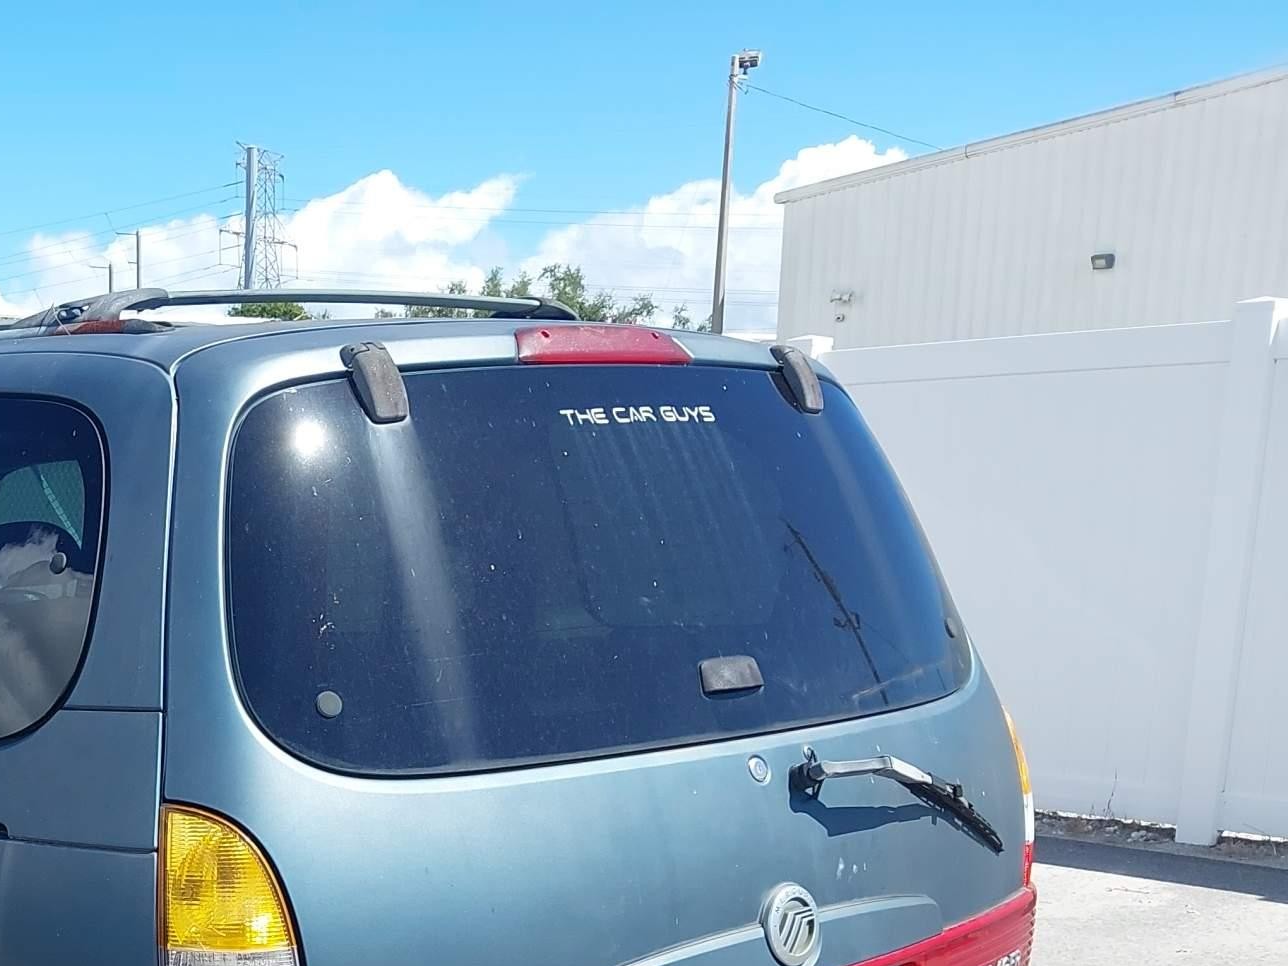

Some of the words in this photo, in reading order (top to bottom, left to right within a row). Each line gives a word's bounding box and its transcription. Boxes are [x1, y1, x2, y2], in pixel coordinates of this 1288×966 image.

[559, 408, 610, 425] THE
[612, 406, 657, 423] CAR
[660, 406, 716, 423] GUYS
